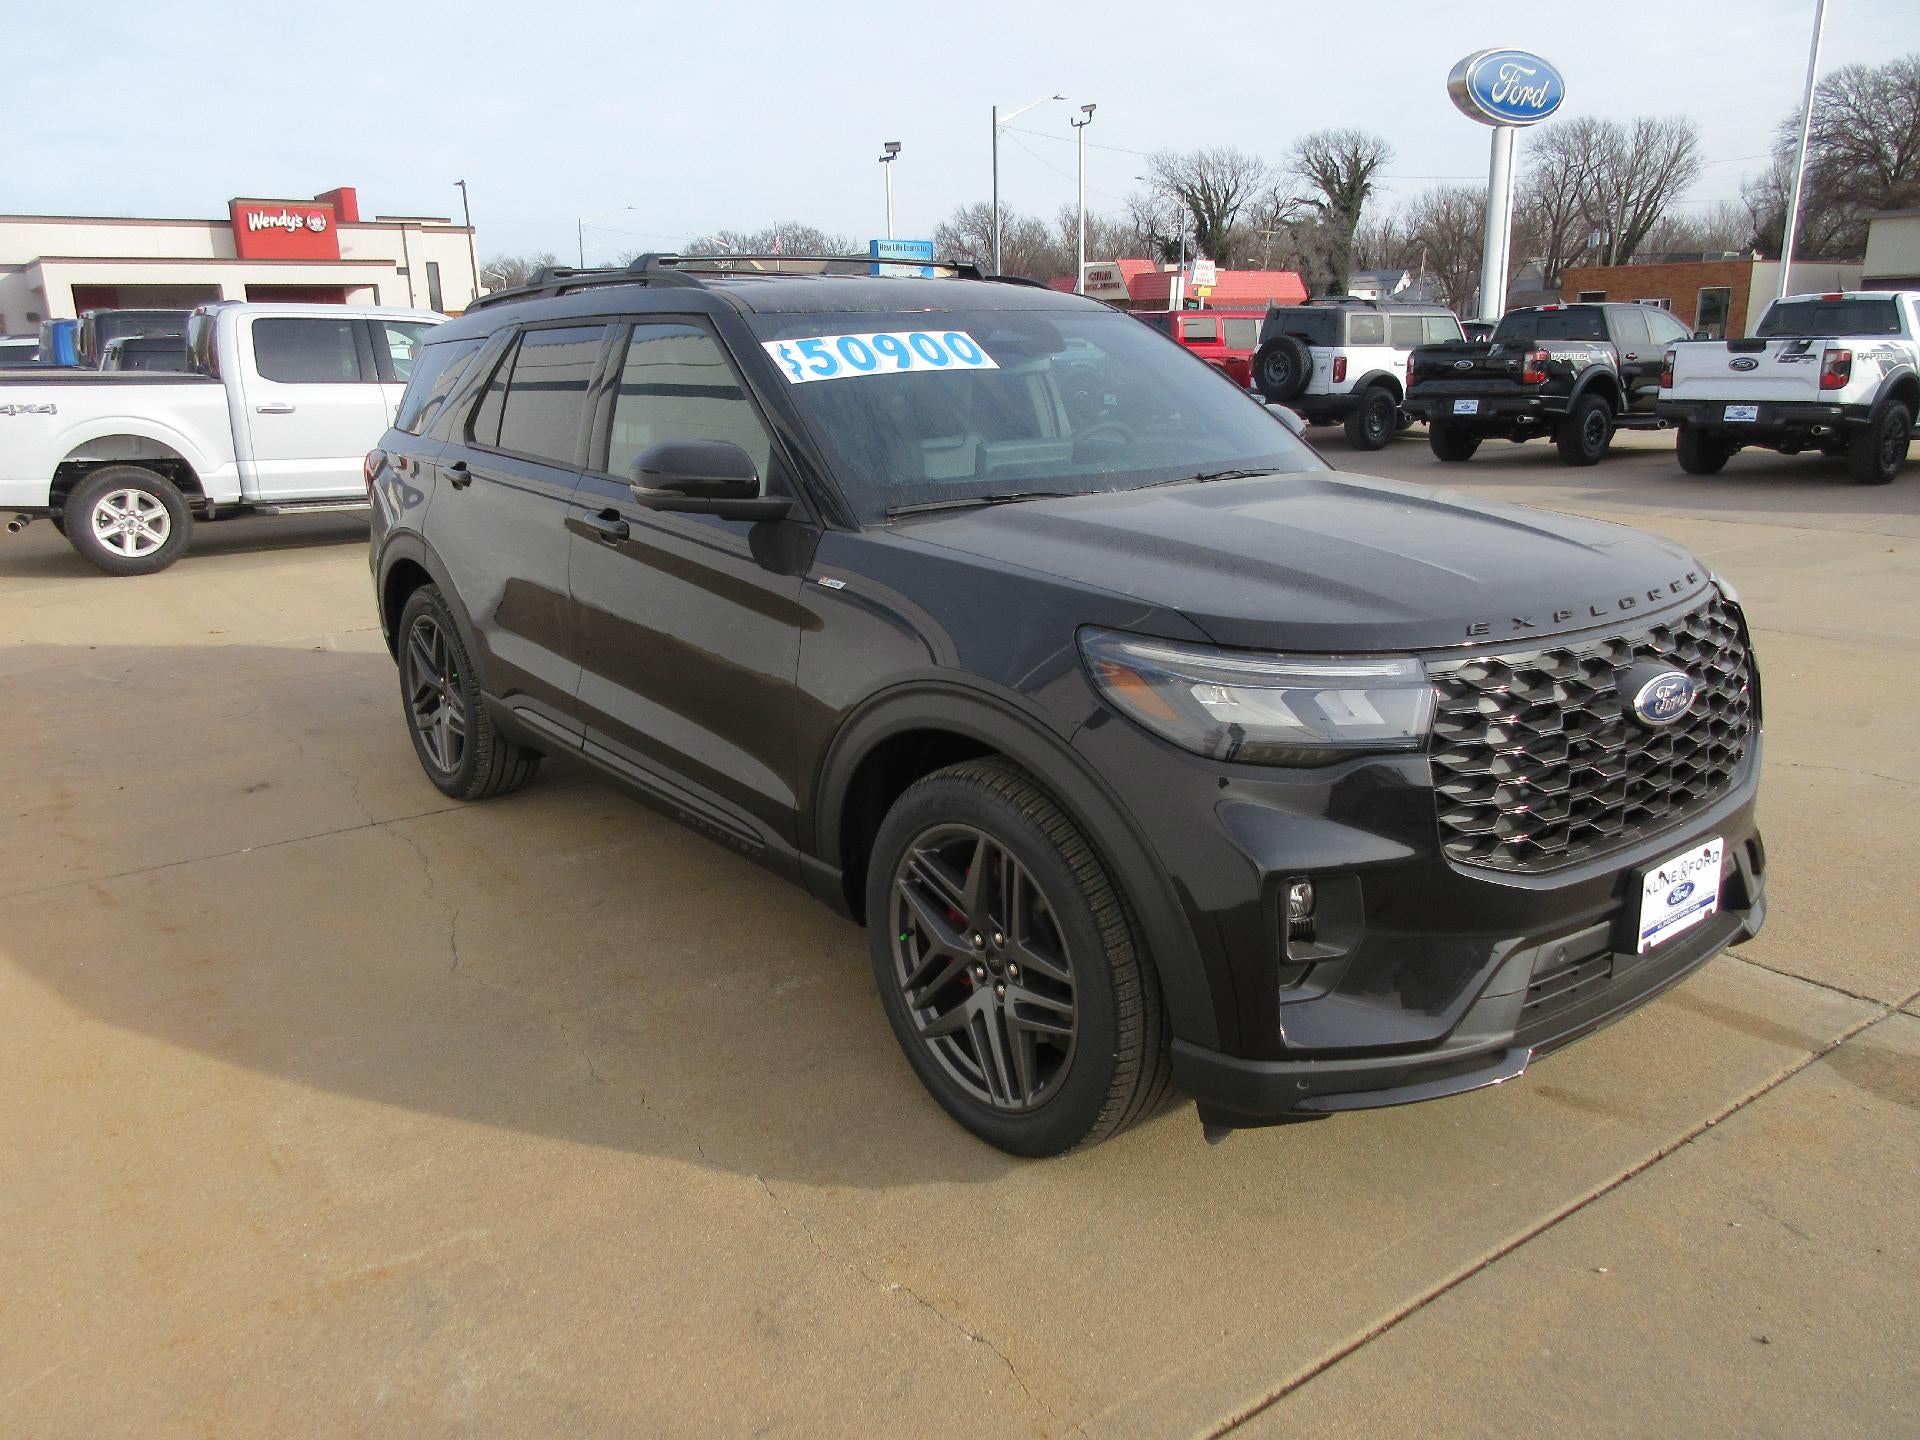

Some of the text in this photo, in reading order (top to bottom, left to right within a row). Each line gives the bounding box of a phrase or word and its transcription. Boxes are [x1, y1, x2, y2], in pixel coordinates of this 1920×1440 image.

[1491, 63, 1549, 108] Ford
[247, 208, 304, 232] Wendy's
[879, 243, 891, 252] New
[776, 332, 986, 380] $50900
[1550, 352, 1590, 362] RAPTOR
[1857, 352, 1893, 361] RAPTOR
[1466, 572, 1698, 636] EXPLORER
[1654, 683, 1687, 715] Ford
[1689, 851, 1720, 875] FORD
